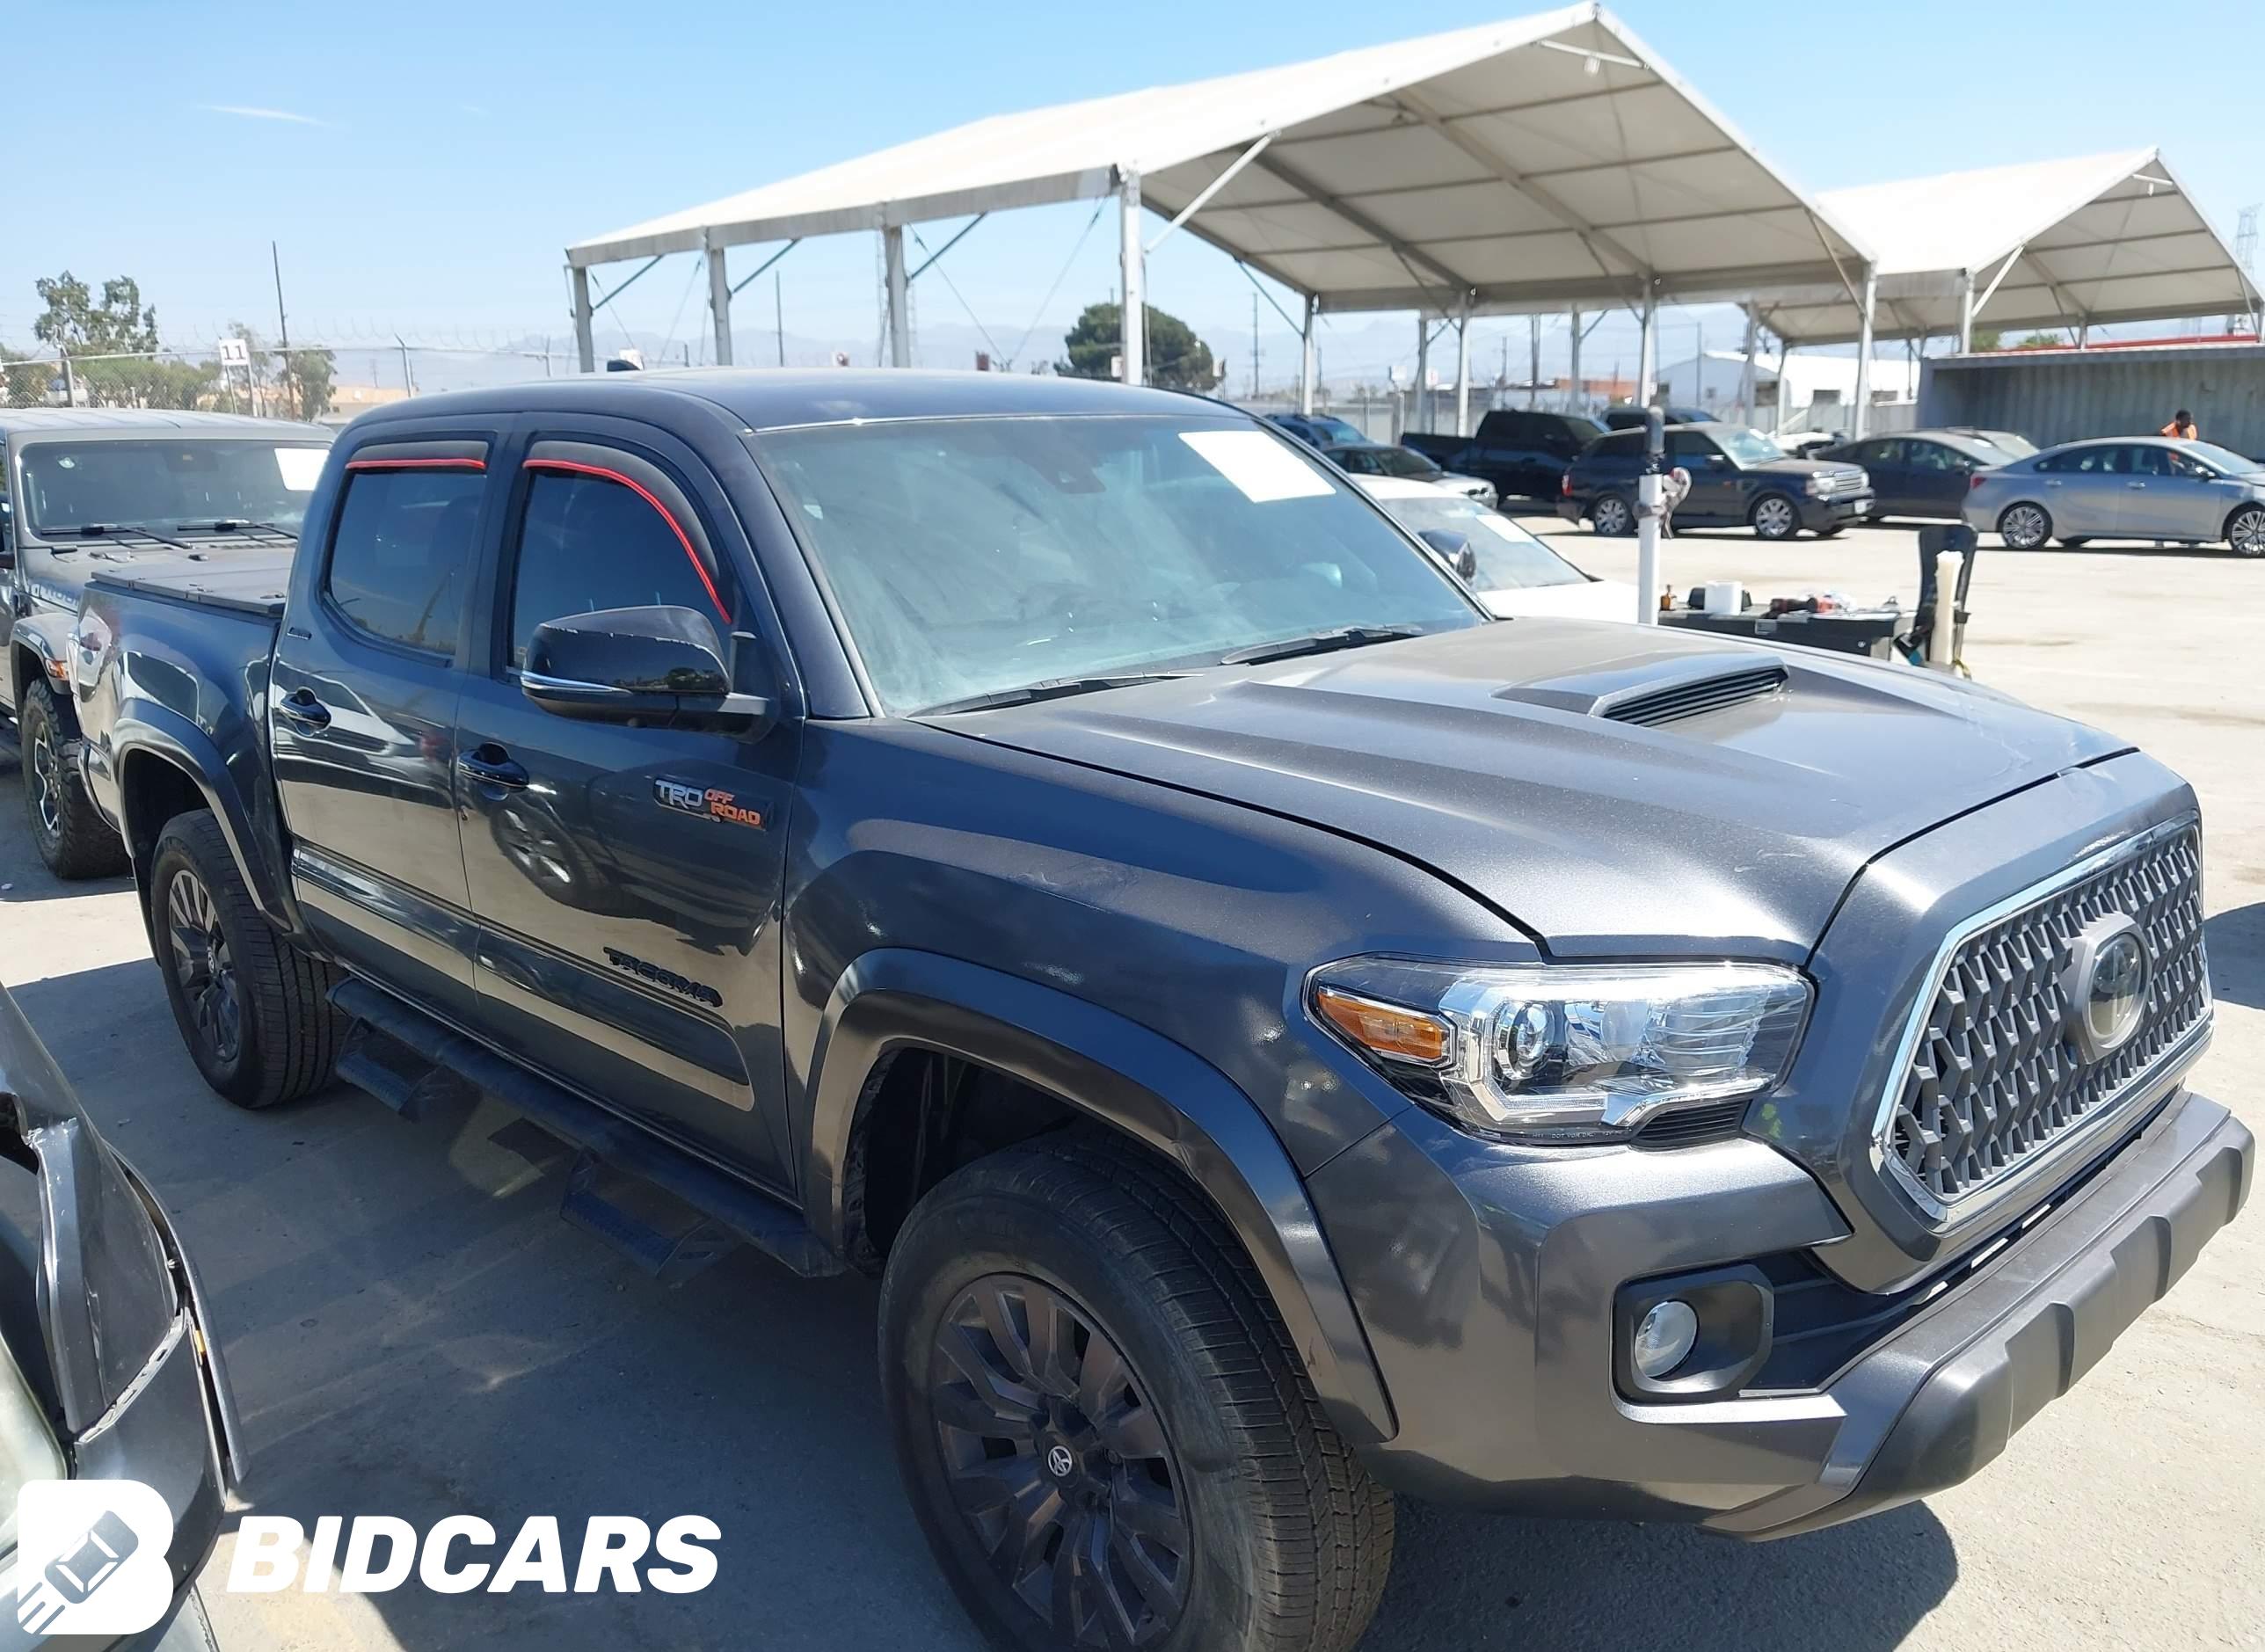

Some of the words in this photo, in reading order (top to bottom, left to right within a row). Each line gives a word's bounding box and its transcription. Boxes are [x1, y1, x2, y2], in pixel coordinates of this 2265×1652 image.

[221, 345, 246, 360] 11
[704, 788, 735, 804] OFF
[710, 801, 761, 825] ROAD
[603, 946, 723, 1008] TACOMA
